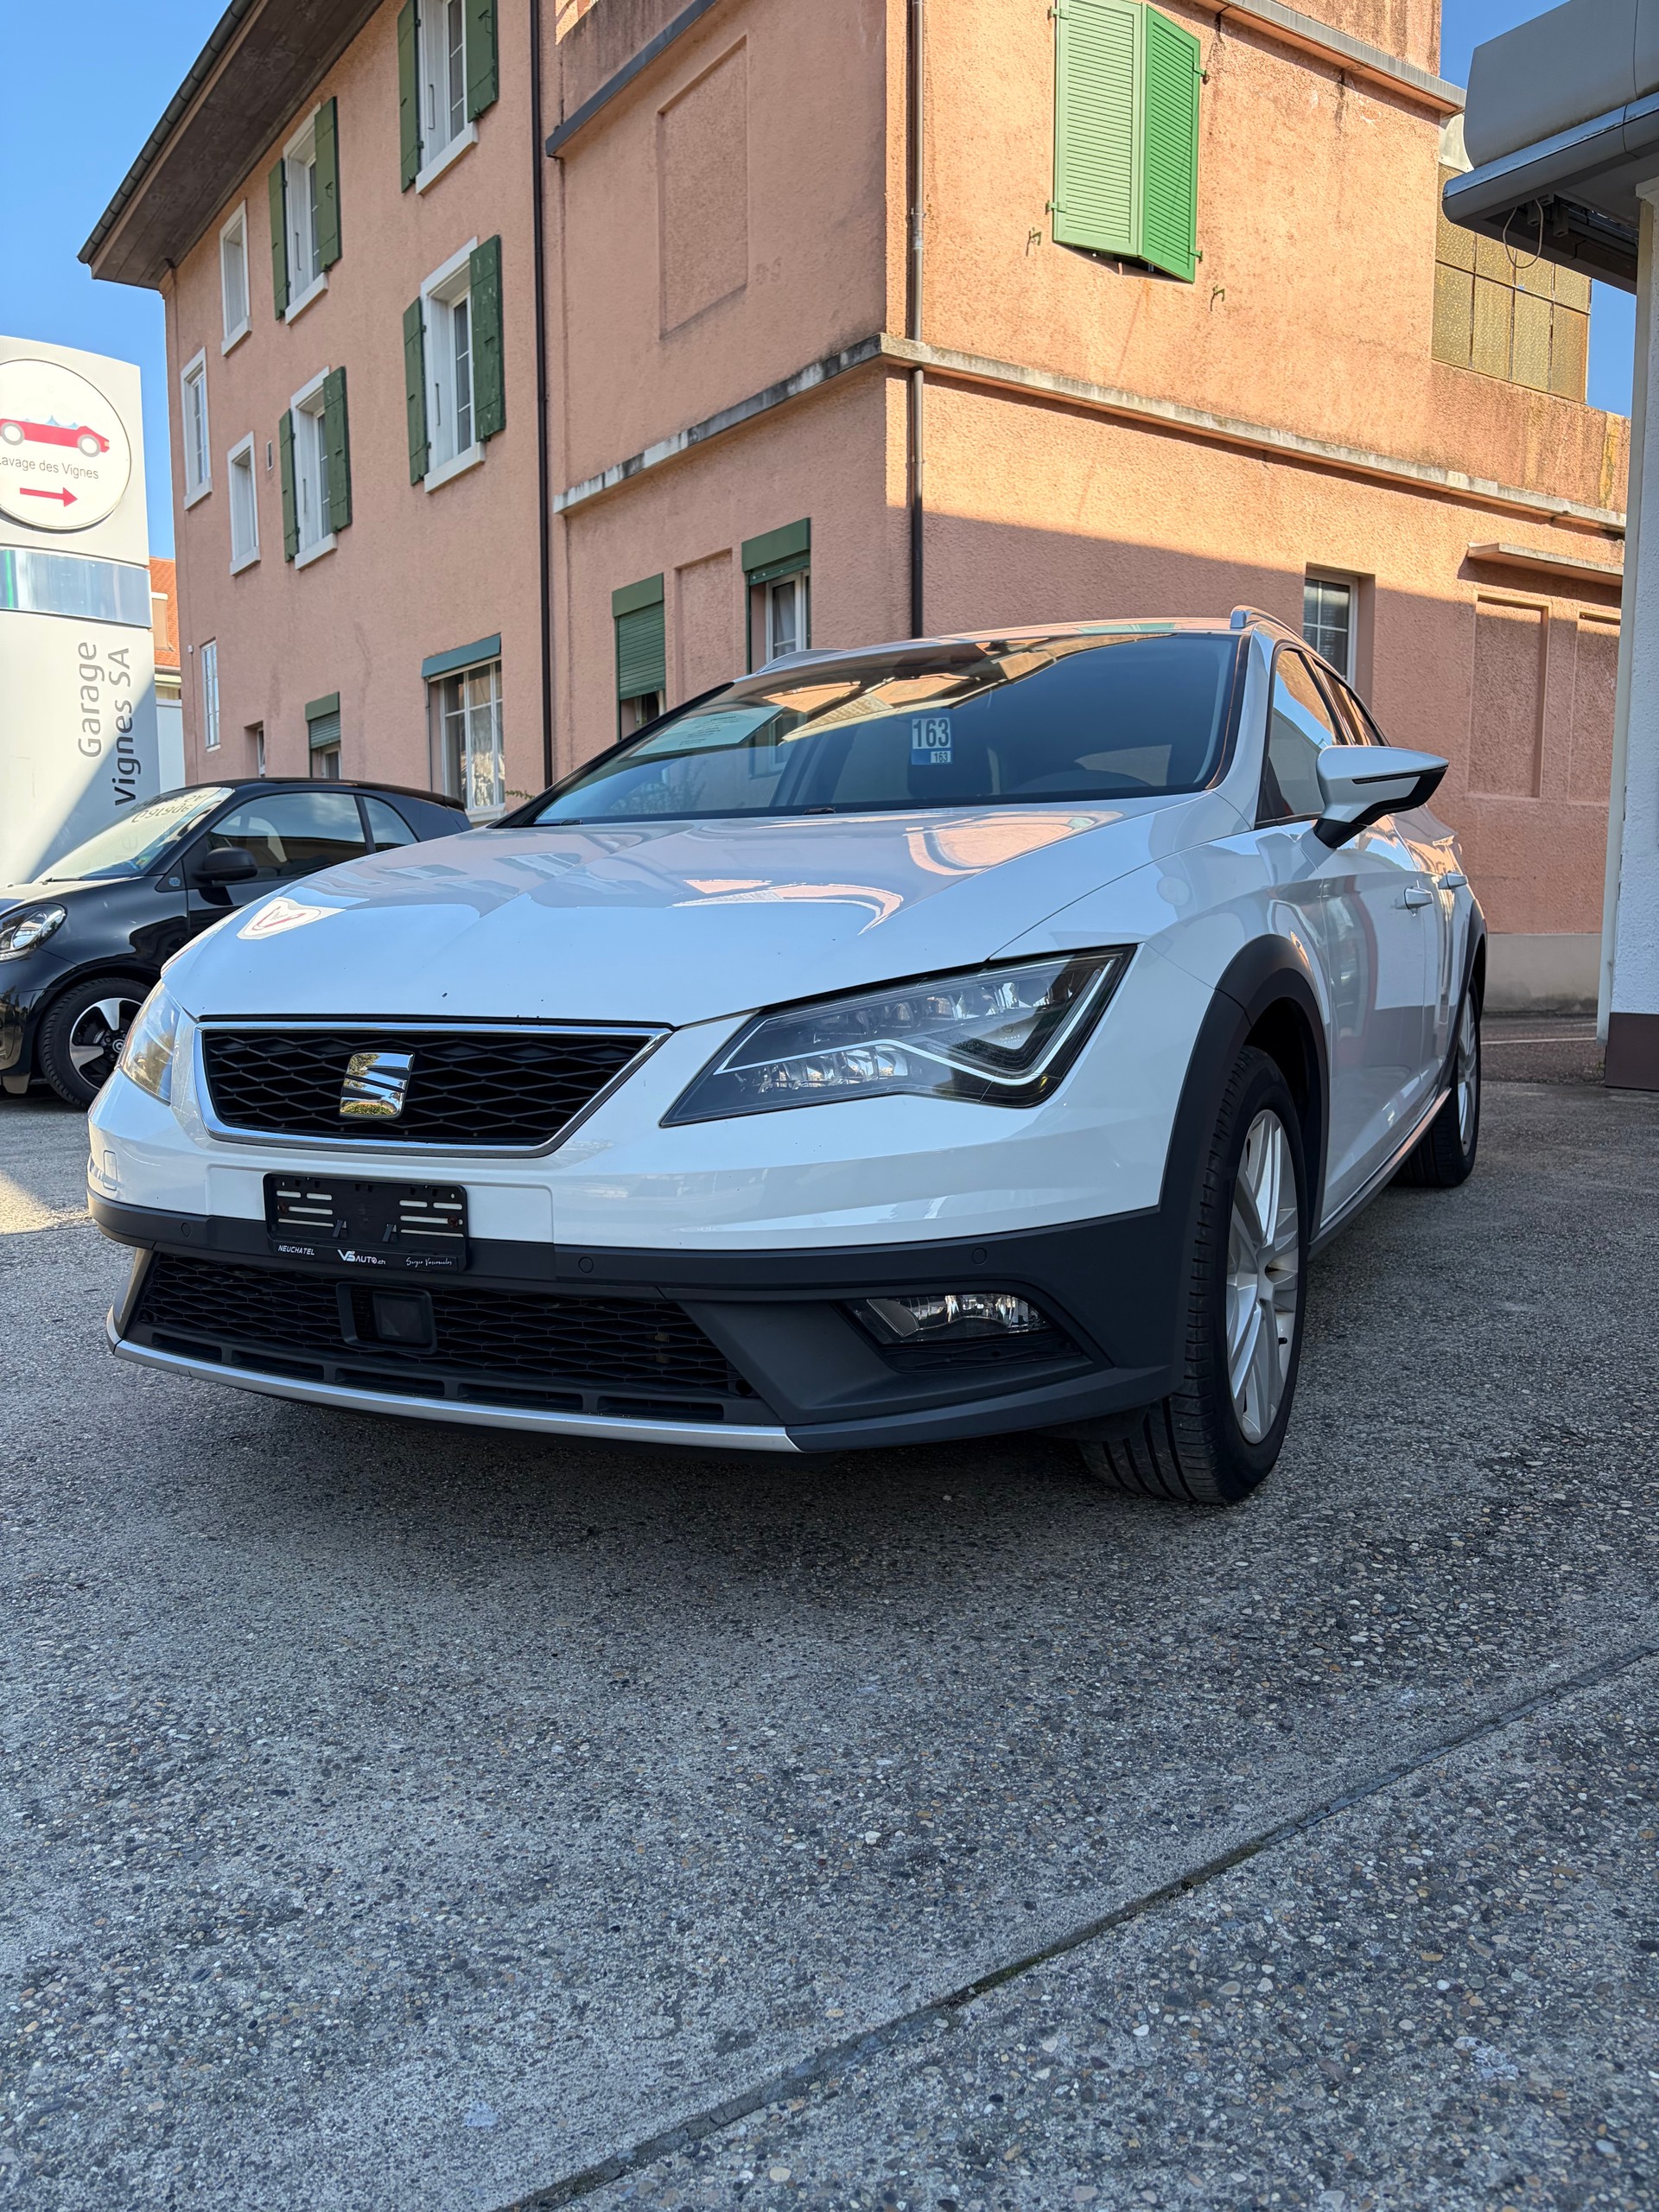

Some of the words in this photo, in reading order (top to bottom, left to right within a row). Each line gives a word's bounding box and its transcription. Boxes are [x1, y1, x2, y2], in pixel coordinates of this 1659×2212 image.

[0, 457, 35, 472] avage
[39, 460, 59, 474] des
[61, 462, 99, 480] Vignes
[108, 648, 130, 687] SA
[78, 642, 105, 757] Garage
[913, 719, 950, 748] 163
[111, 700, 141, 806] Vignes
[934, 752, 949, 762] 163
[277, 1244, 315, 1256] NEUCHATEL
